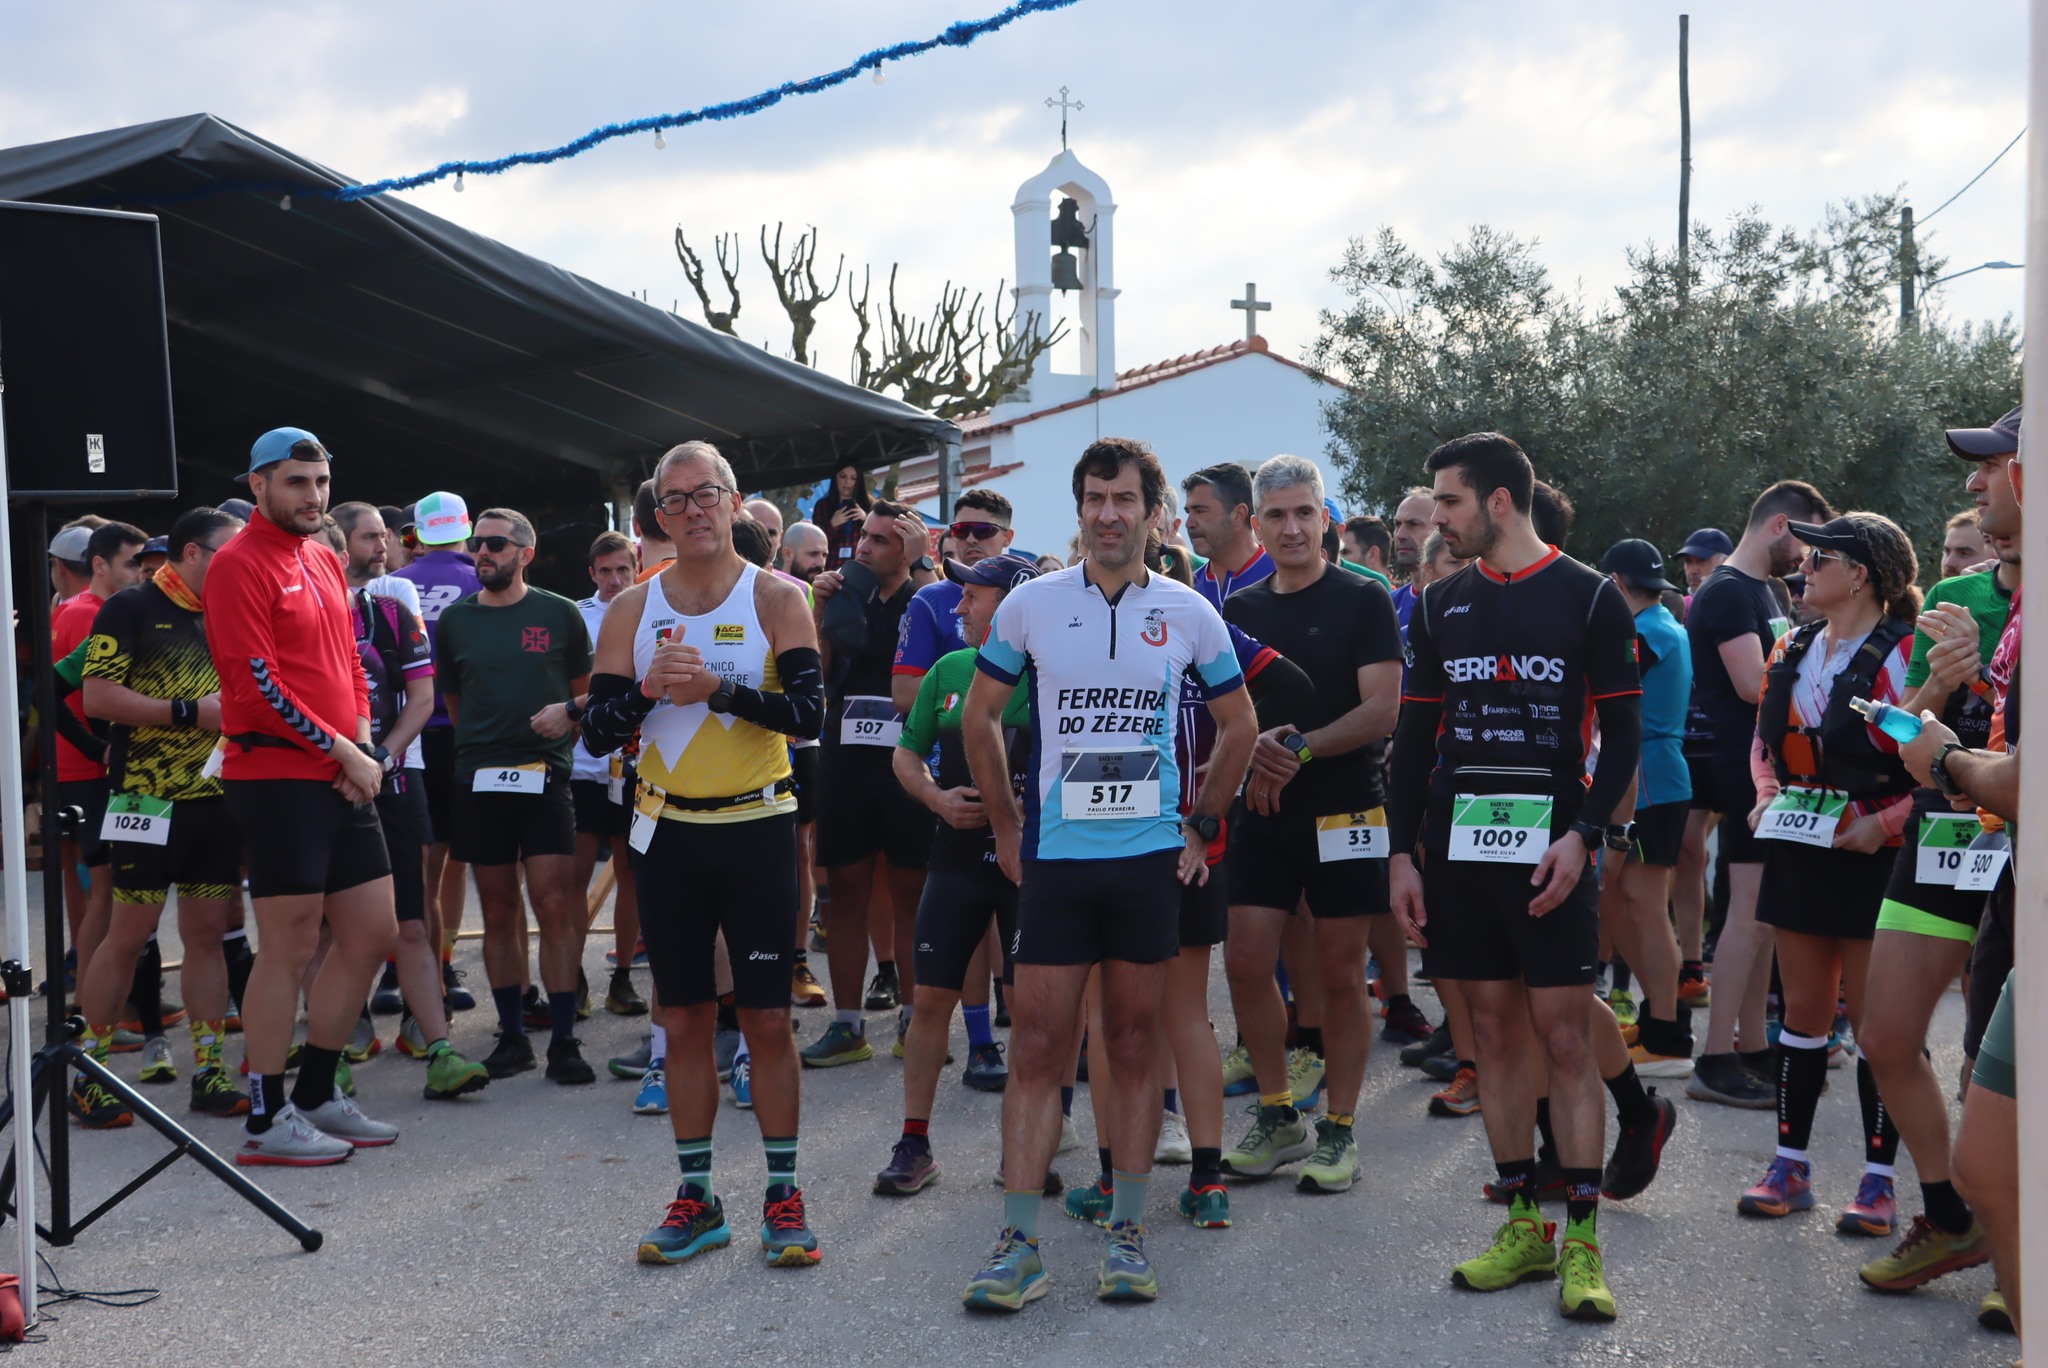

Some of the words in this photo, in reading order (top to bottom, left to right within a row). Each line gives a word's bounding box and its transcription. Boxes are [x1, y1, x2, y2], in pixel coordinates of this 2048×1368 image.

[89, 437, 101, 450] HK
[1443, 654, 1566, 683] SERRANOS
[1057, 688, 1167, 711] FERREIRA
[855, 721, 884, 735] 507
[1058, 716, 1085, 734] DO
[1090, 712, 1165, 735] ZÊZERE
[1492, 729, 1525, 737] WAGNER
[497, 770, 520, 783] 40
[1090, 784, 1133, 805] 517
[115, 815, 151, 832] 1028
[1775, 812, 1820, 831] 1001
[1348, 829, 1372, 846] 33
[1472, 829, 1528, 848] 1009
[1937, 851, 1967, 870] 10
[1970, 853, 1993, 874] 500
